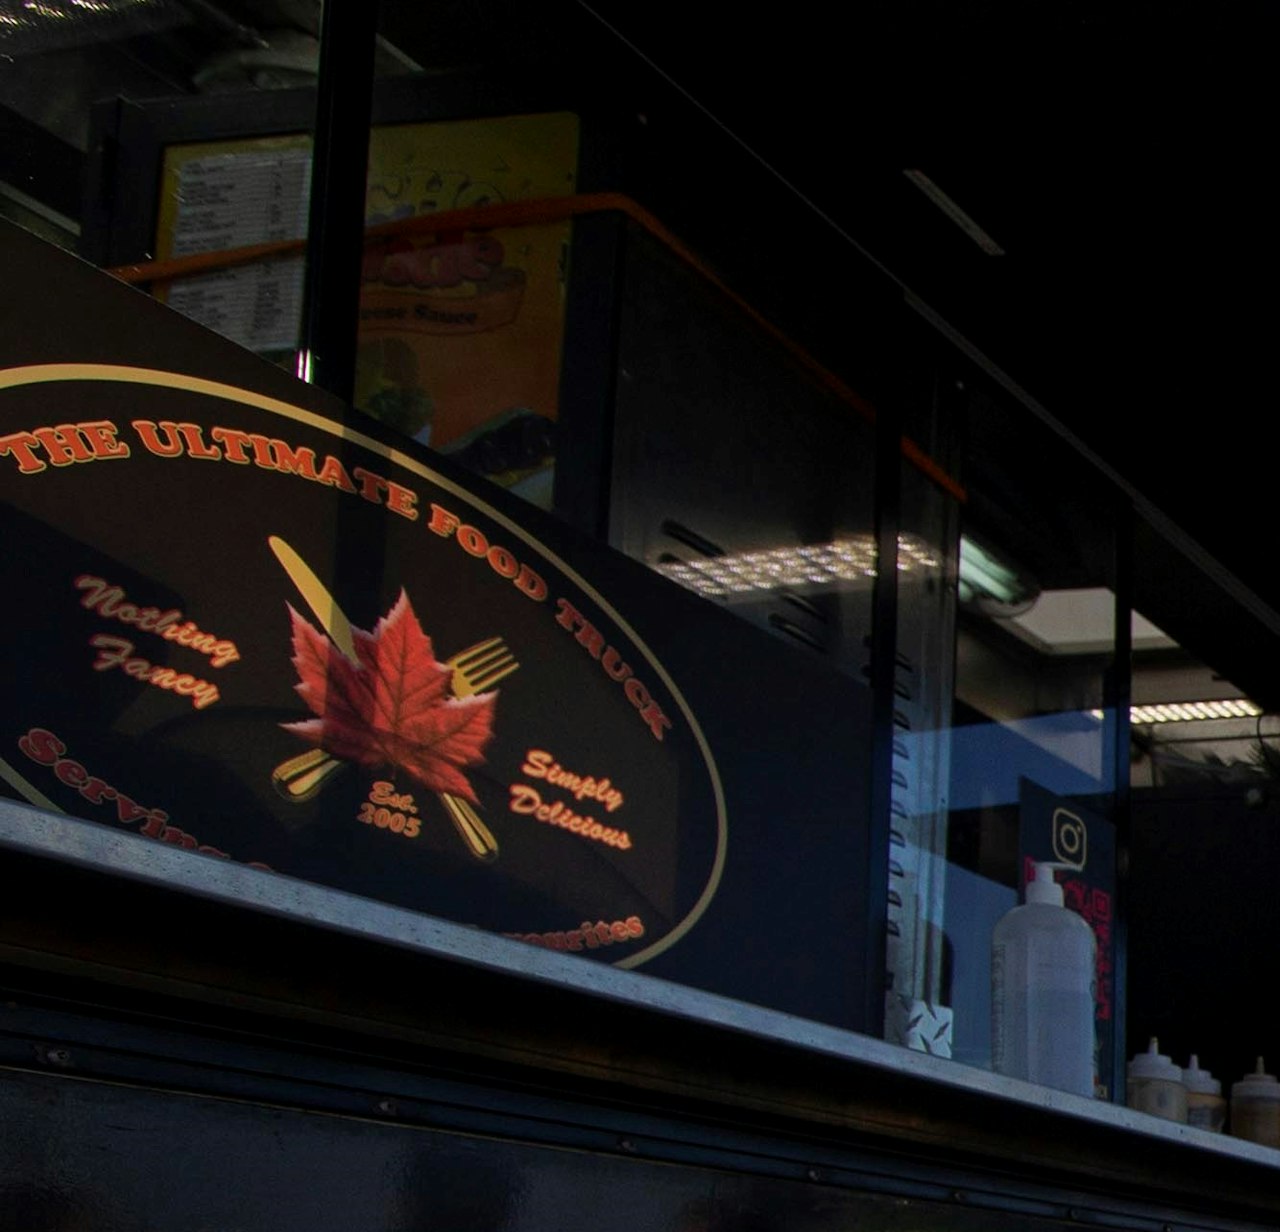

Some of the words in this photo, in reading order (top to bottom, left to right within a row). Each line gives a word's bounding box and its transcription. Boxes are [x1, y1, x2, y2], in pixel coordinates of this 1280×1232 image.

[0, 420, 130, 474] THE
[132, 419, 419, 521] ULTIMATE
[428, 502, 548, 602] FOOD
[555, 598, 673, 742] TRUCK
[75, 574, 241, 668] Nothing
[90, 633, 221, 710] Fancy
[18, 727, 231, 858] Servin
[368, 780, 418, 814] Est.
[521, 748, 625, 812] Simply
[356, 802, 422, 838] 2005
[508, 783, 634, 851] Delicious
